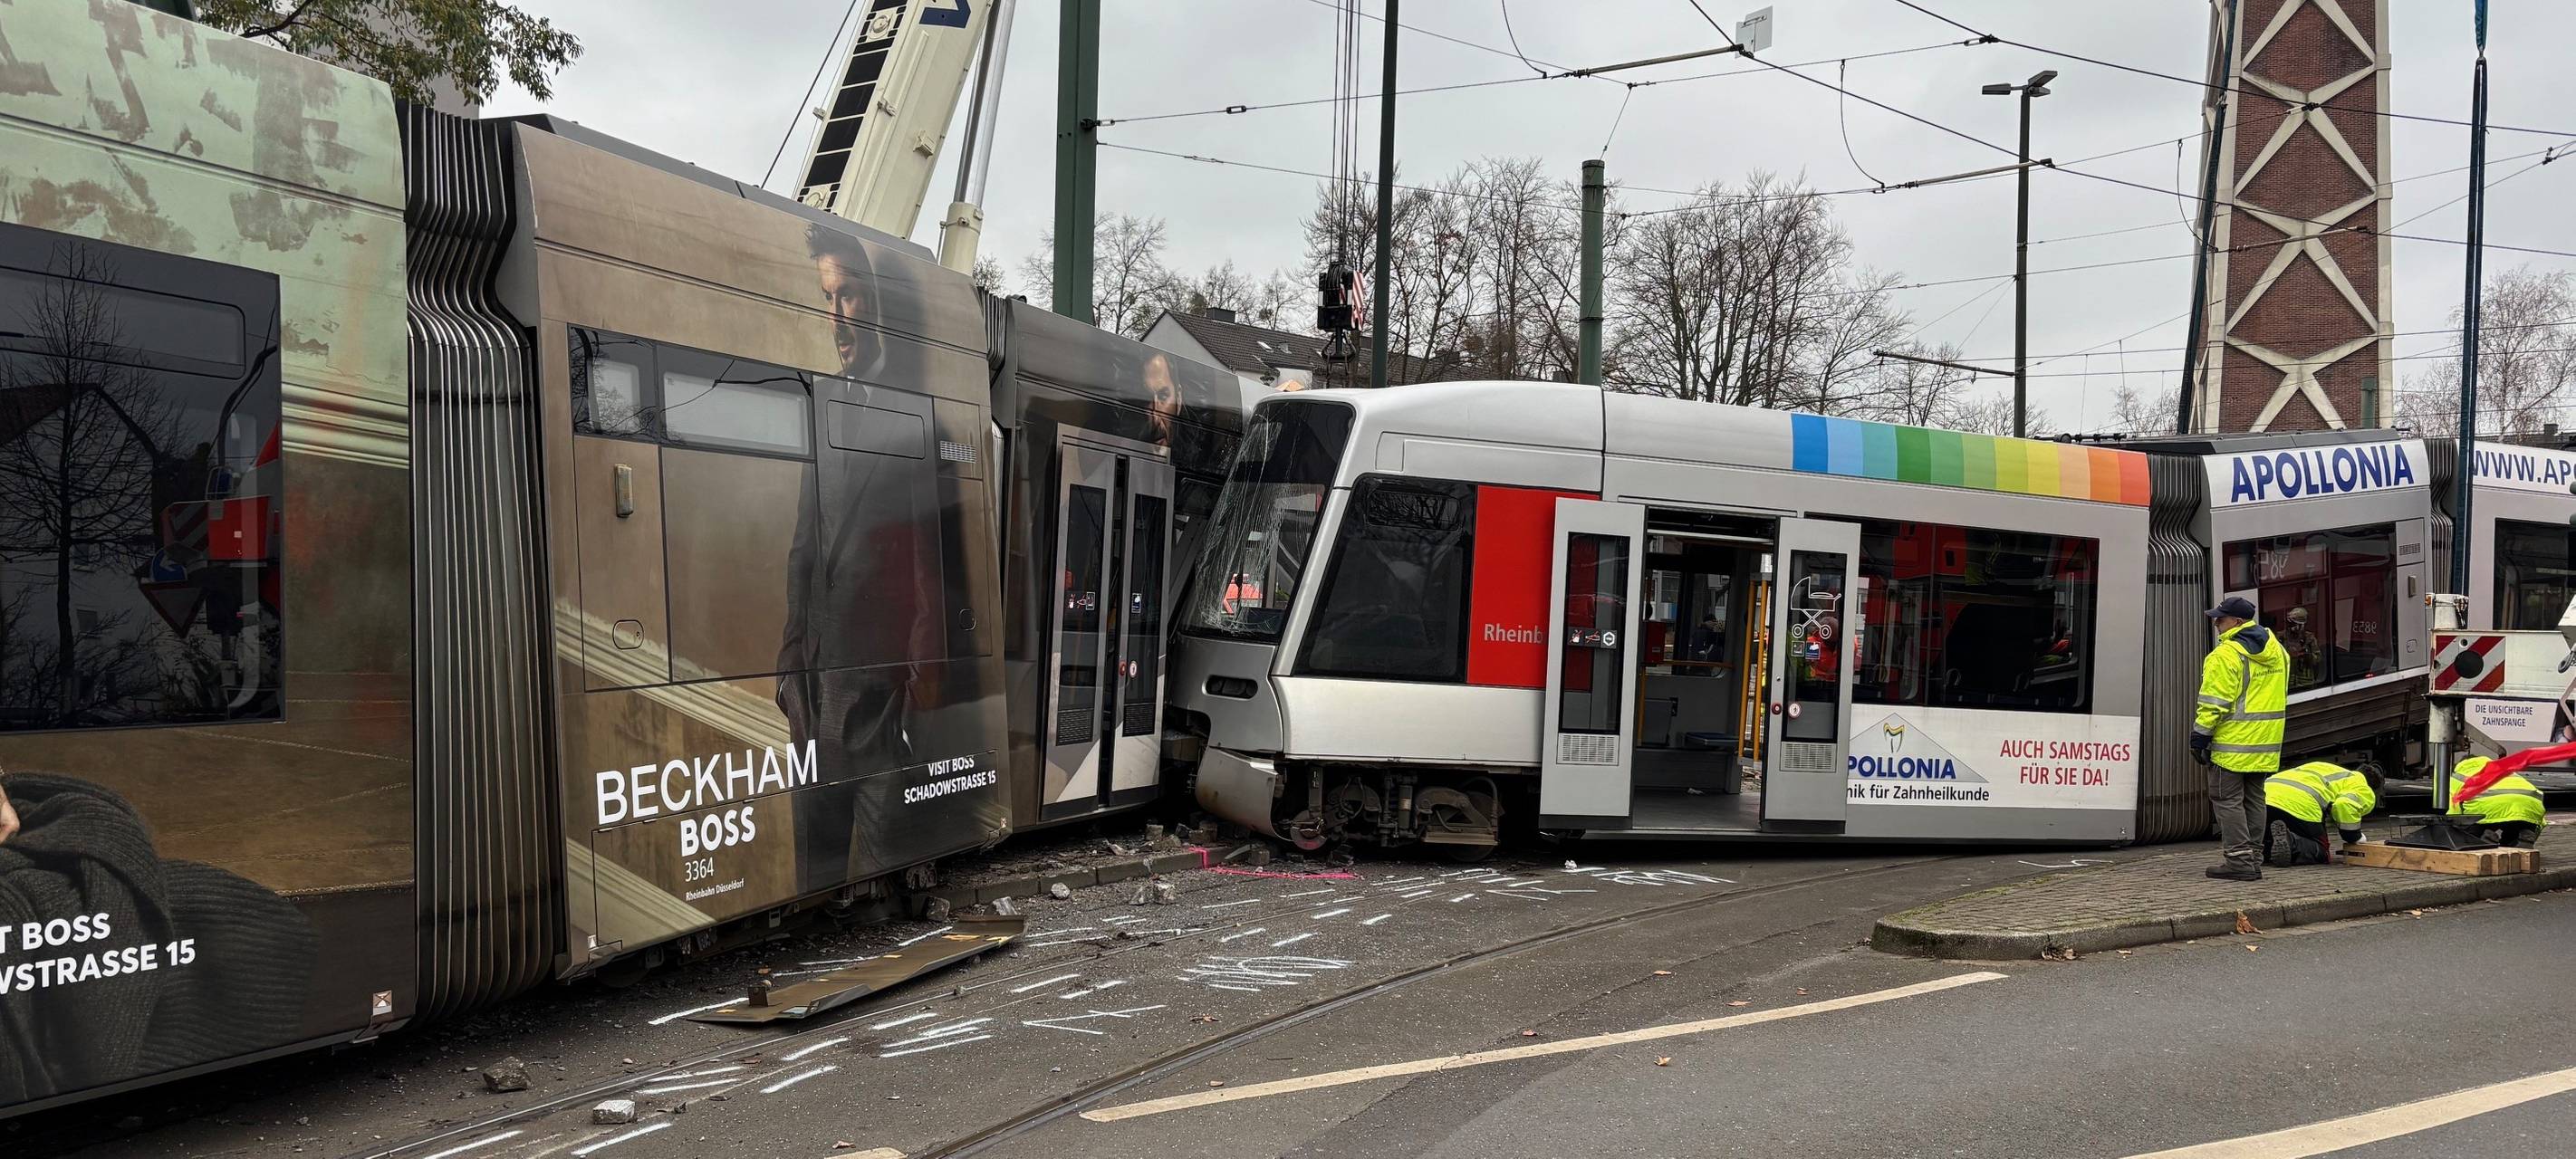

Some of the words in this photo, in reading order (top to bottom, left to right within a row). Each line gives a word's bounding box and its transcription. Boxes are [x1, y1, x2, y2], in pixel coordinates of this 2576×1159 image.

[2231, 444, 2415, 503] APOLLONIA
[2473, 450, 2576, 485] WWW.AP
[2475, 704, 2486, 714] DIE
[2488, 705, 2533, 715] UNSICHTBARE
[2482, 716, 2526, 727] ZAHNSPANGE
[2000, 740, 2043, 759] AUCH
[2049, 741, 2130, 761] SAMSTAGS
[928, 759, 951, 777] VISIT
[952, 755, 975, 772] BOSS
[2020, 762, 2049, 784] FÜR
[2054, 767, 2077, 785] SIE
[2082, 768, 2109, 786] DA!
[596, 739, 818, 825] BECKHAM
[904, 771, 987, 804] SCHADOWSTRASSE
[987, 771, 996, 784] 15
[1870, 784, 1889, 799] für
[1893, 785, 1990, 801] Zahnheilkunde
[680, 806, 755, 857] BOSS
[685, 857, 715, 882] 3364
[686, 886, 716, 901] Rheinbahn
[716, 878, 745, 894] Düsseldorf
[22, 913, 111, 950] BOSS
[166, 938, 196, 966] 15
